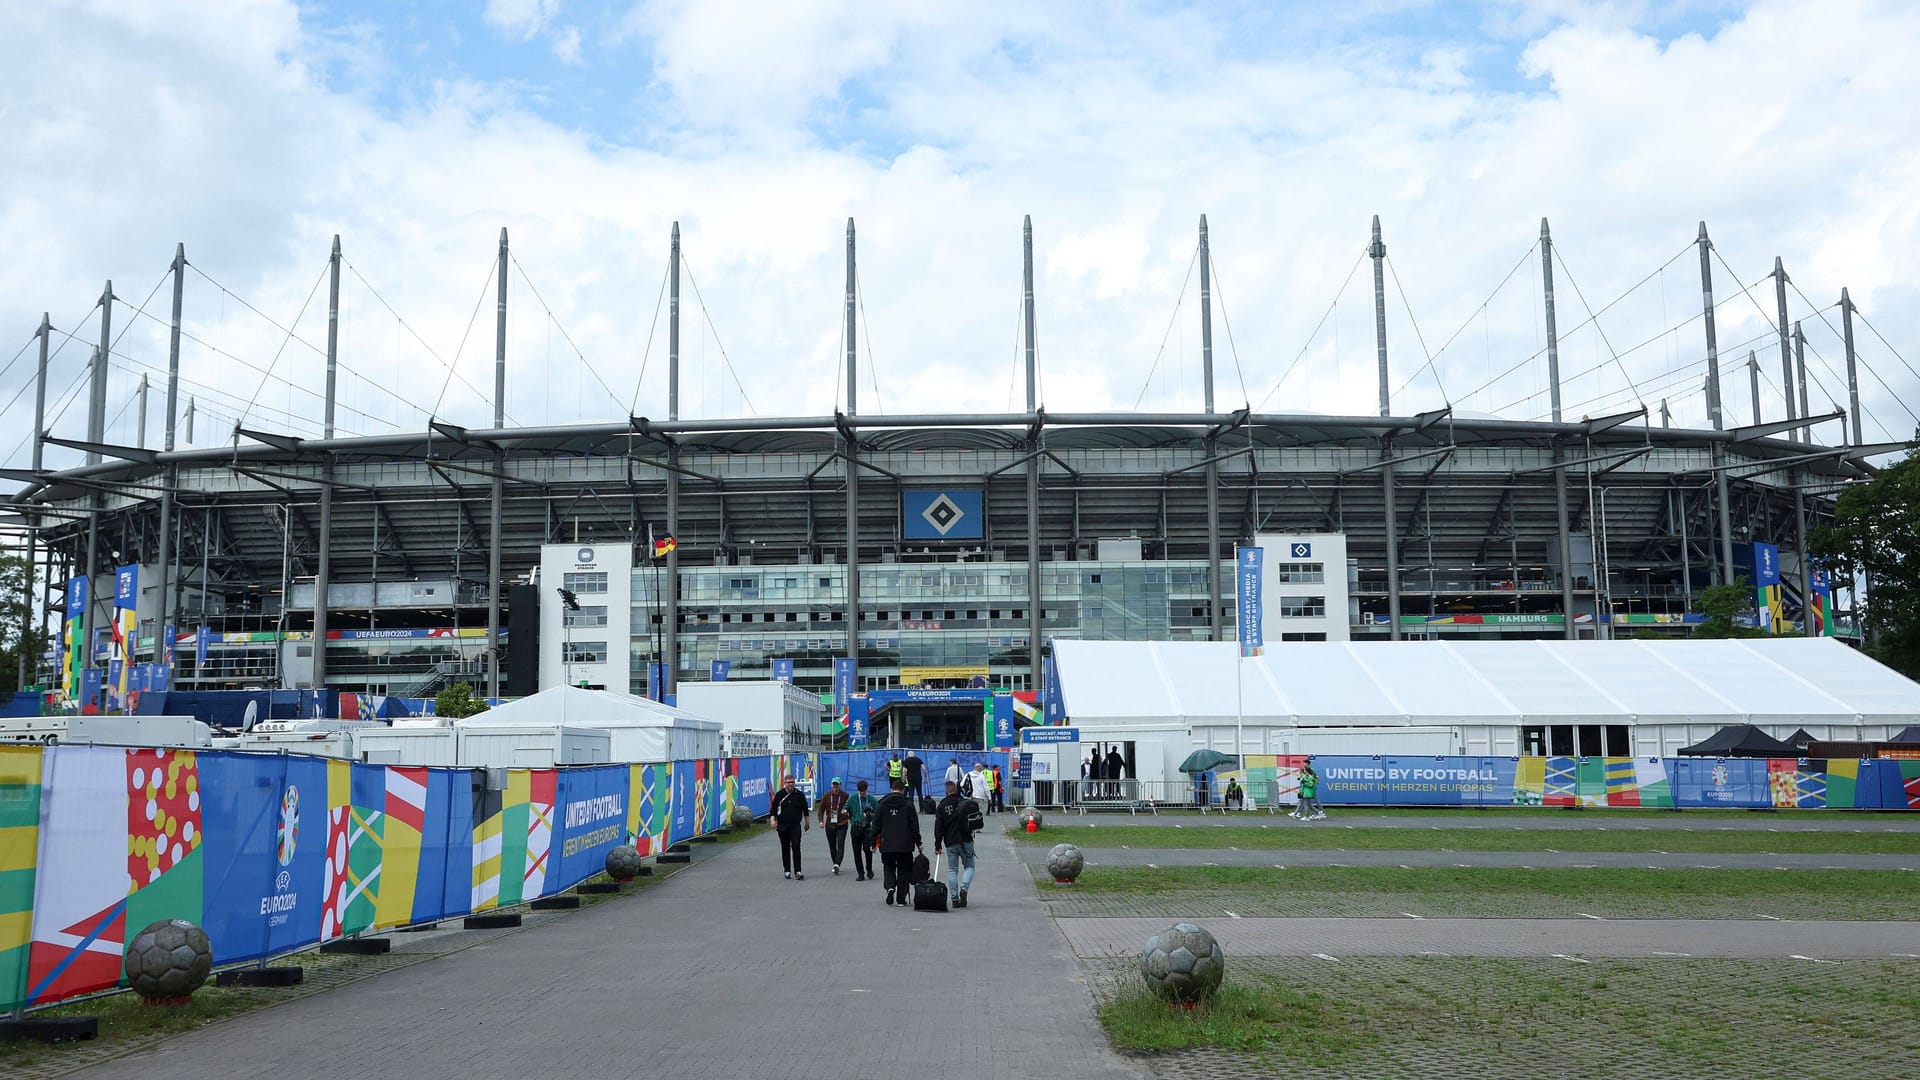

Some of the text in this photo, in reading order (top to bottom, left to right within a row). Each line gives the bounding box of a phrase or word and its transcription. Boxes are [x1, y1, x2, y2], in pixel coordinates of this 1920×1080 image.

[1498, 615, 1549, 623] HAMBURG
[1325, 768, 1498, 781] UNITED BY FOOTBALL
[1326, 782, 1494, 792] VEREINT IM HERZEN EUROPAS
[565, 800, 587, 829] UNITED
[593, 793, 623, 822] FOOTBALL
[260, 892, 297, 915] EURO2024
